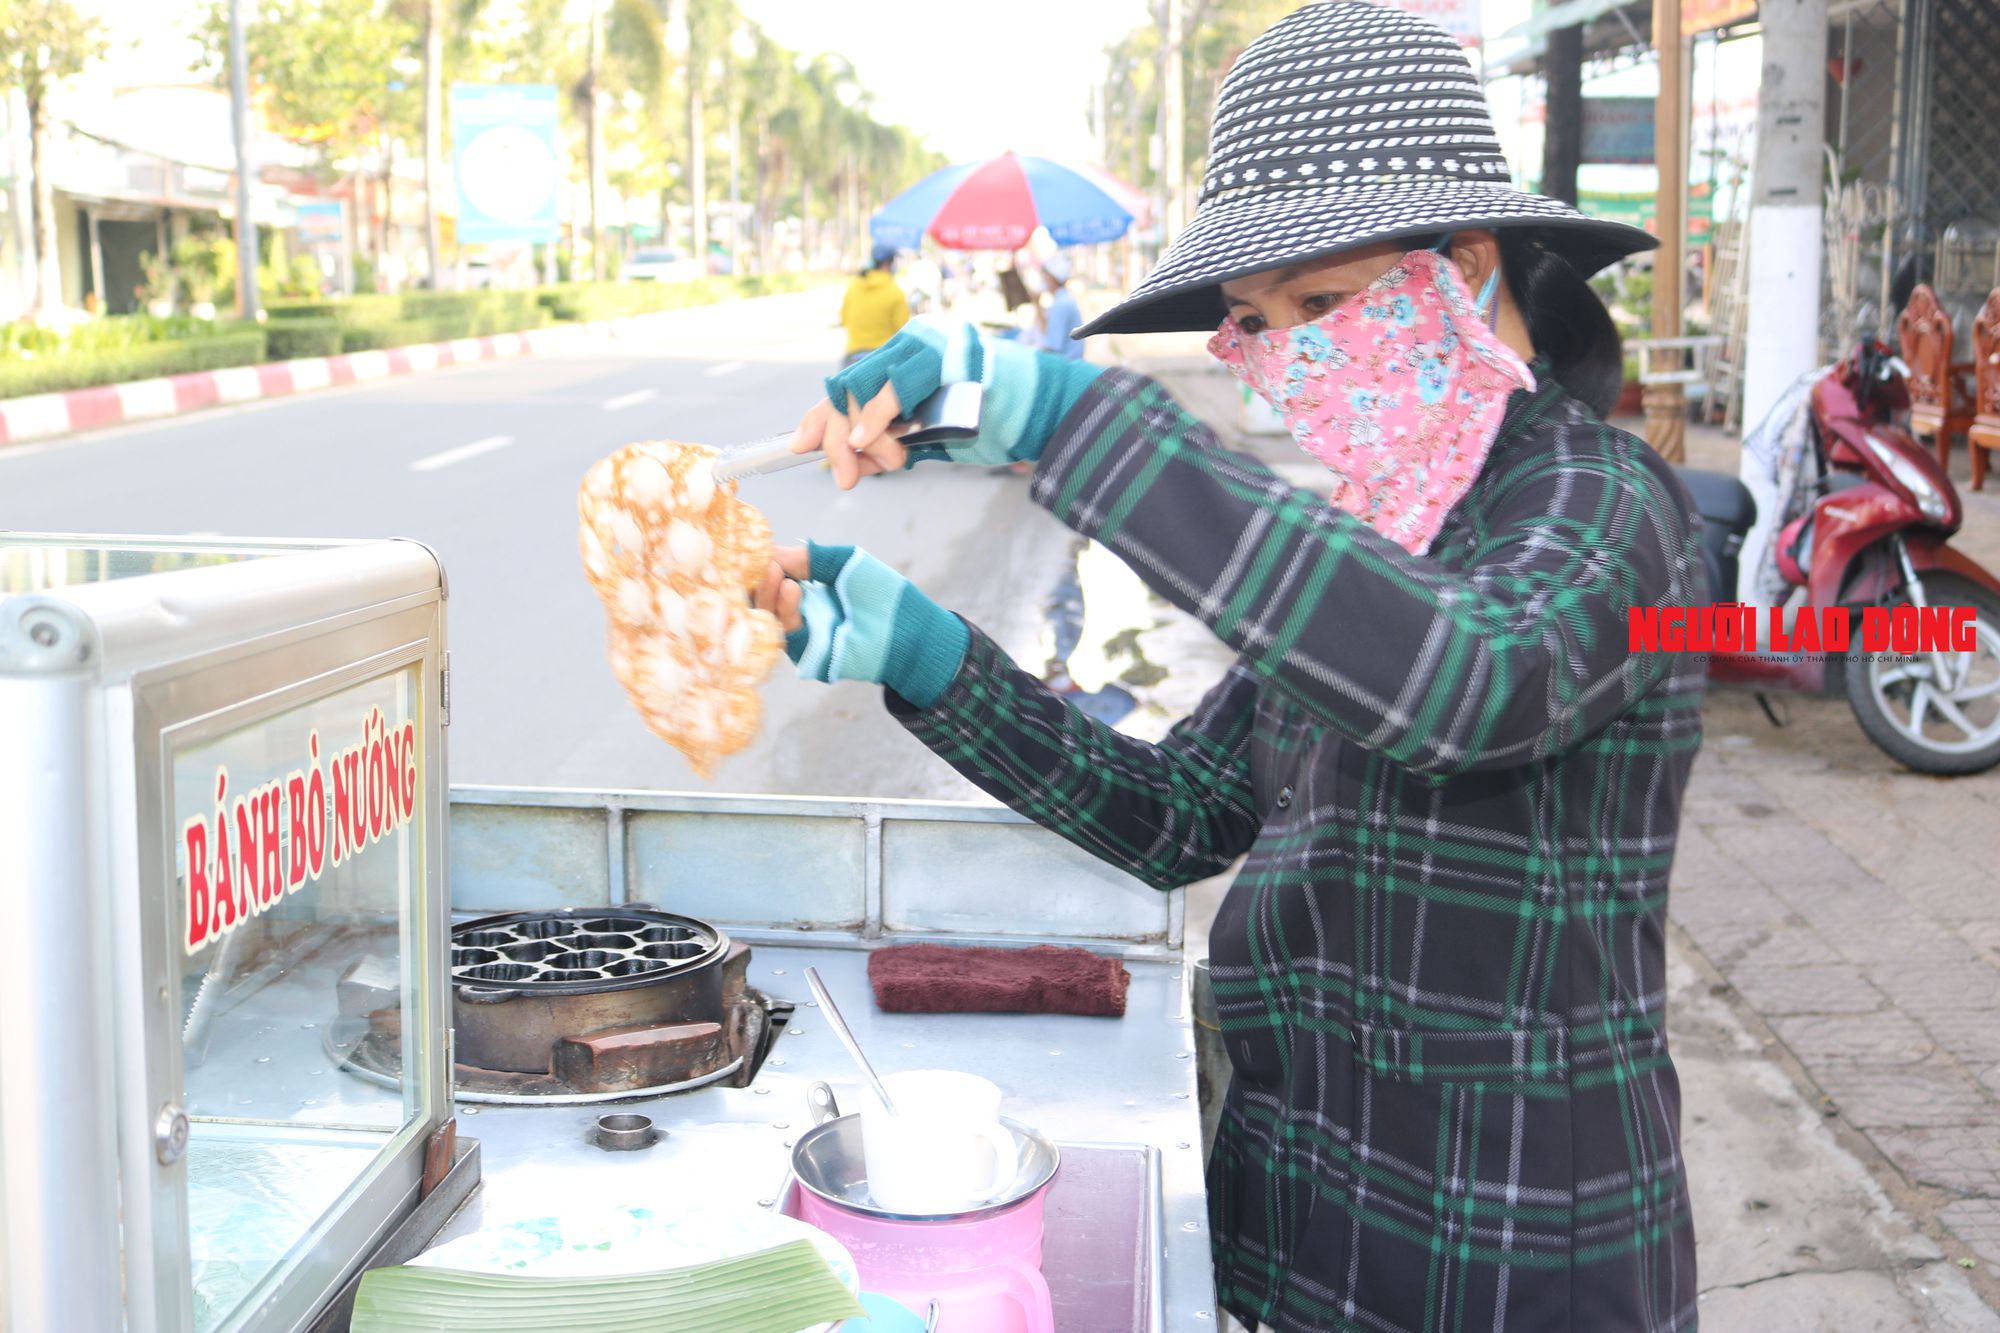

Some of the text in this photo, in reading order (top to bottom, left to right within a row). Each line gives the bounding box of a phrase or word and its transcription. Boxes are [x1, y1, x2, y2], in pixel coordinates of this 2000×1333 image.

[186, 706, 416, 949] BÁNH BÒ NƯỚNG
